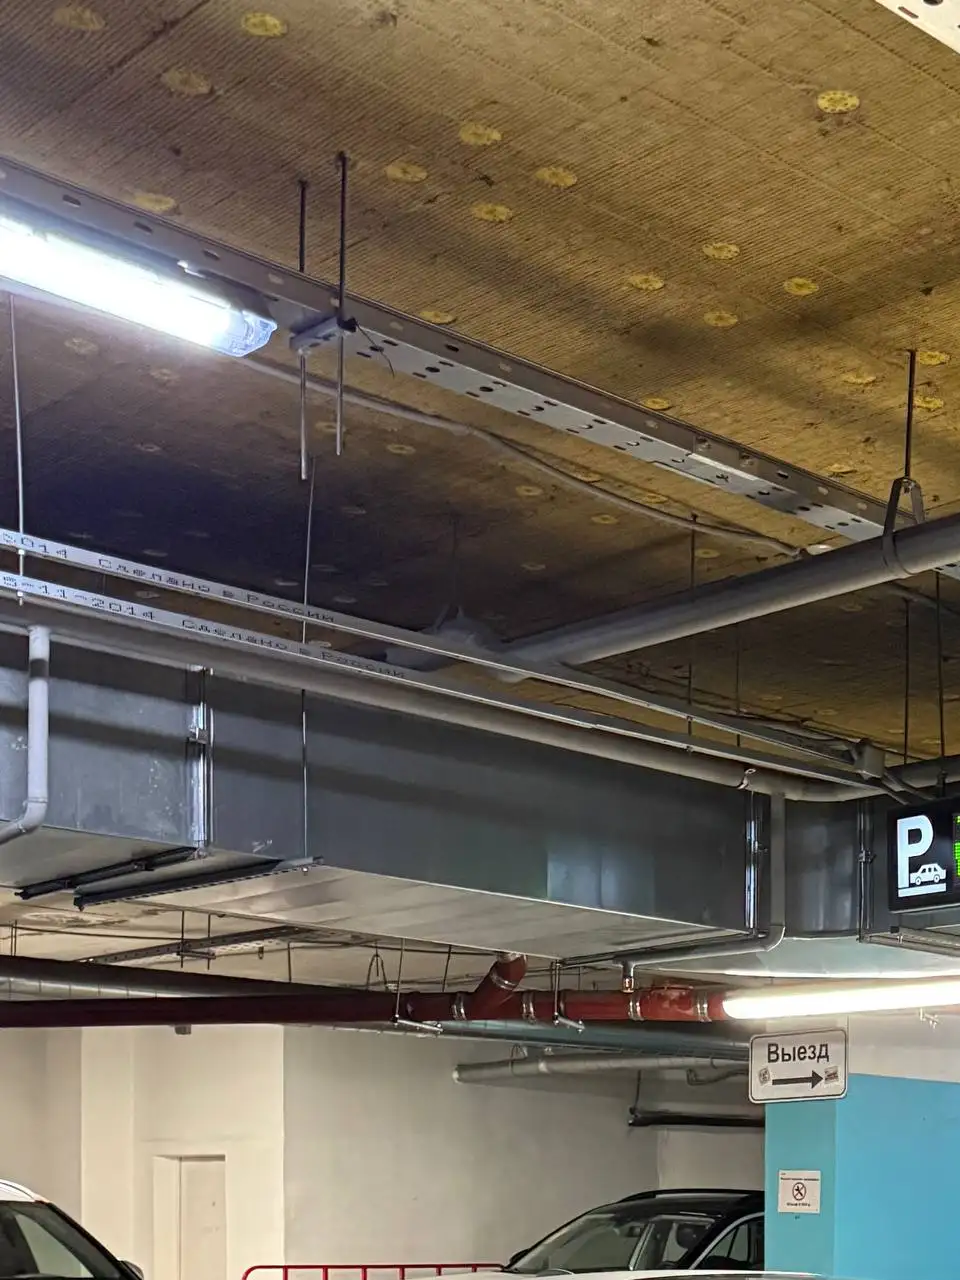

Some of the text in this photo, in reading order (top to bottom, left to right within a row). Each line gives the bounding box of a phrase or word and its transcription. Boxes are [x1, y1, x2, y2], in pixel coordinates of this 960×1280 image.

[98, 558, 210, 593] Сделано
[246, 593, 335, 623] России
[182, 619, 288, 650] Сделано
[896, 814, 934, 888] P
[767, 1043, 830, 1063] Выезд
